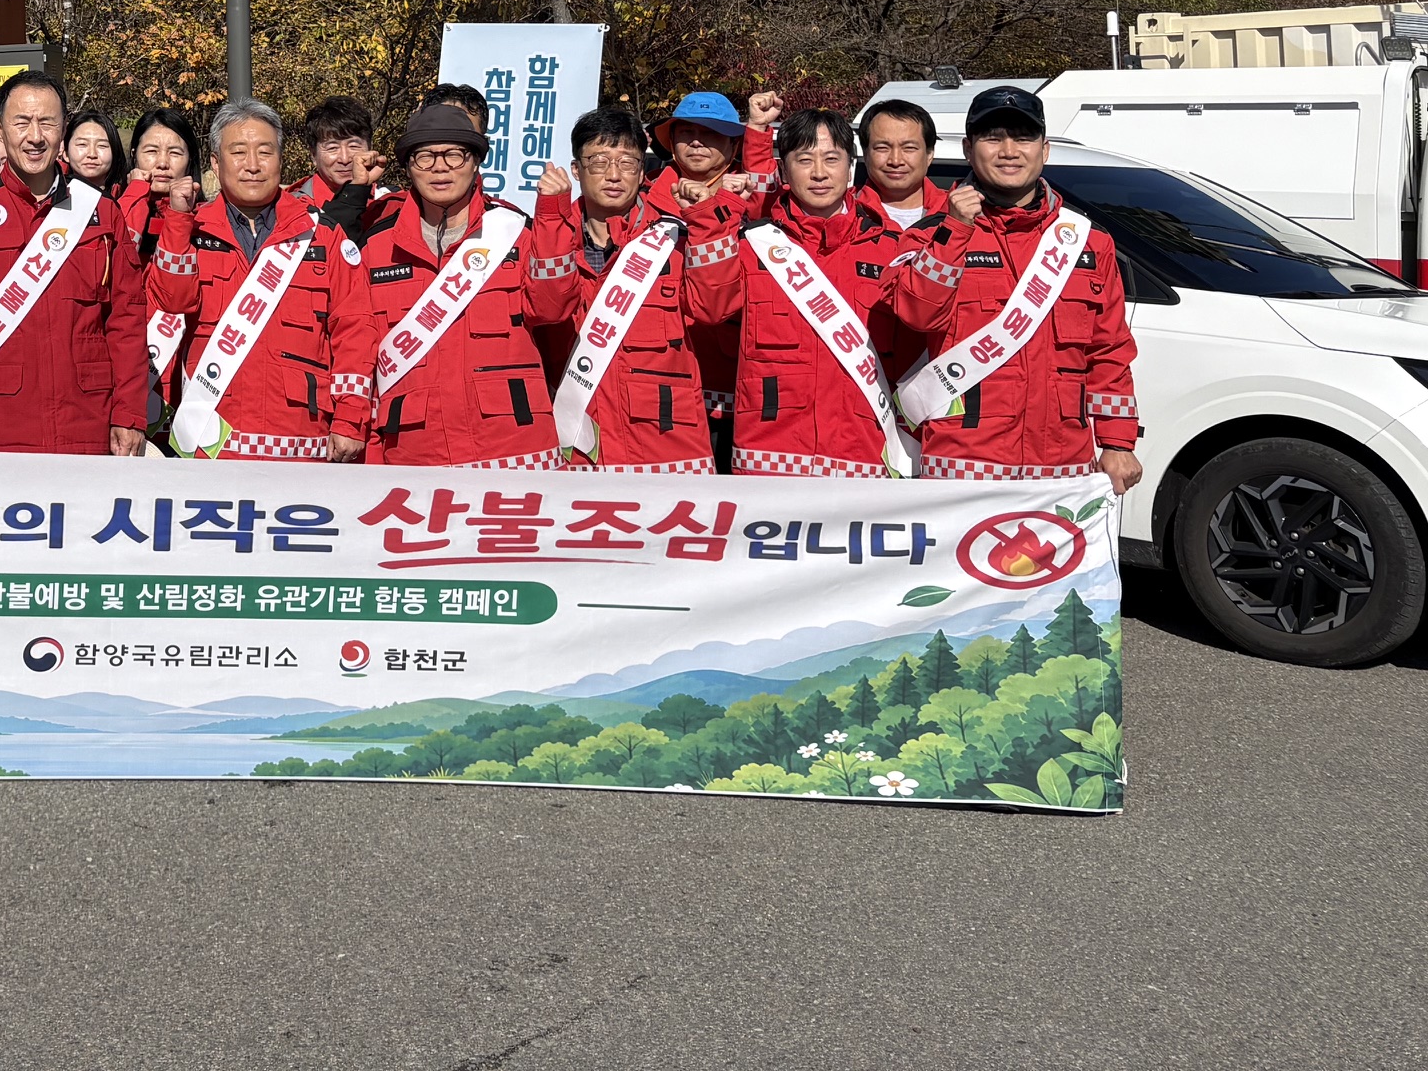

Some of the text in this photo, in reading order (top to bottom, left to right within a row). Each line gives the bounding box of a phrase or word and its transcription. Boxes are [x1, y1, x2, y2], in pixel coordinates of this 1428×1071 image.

[518, 54, 560, 192] 함께해요
[587, 228, 671, 349] 산불예방
[969, 245, 1069, 365] 산불예방
[377, 272, 472, 378] 산불예방
[785, 259, 880, 386] 산불예방
[196, 373, 221, 397] 서부지방산림청
[933, 364, 958, 395] 서부지방산림청
[91, 497, 339, 554] 시작은
[100, 582, 125, 610] 및
[135, 582, 245, 613] 산림정화
[254, 583, 365, 614] 유관기관
[374, 585, 428, 616] 합동
[438, 586, 519, 618] 캠페인
[73, 641, 300, 670] 함양국유림관리소
[383, 647, 468, 672] 합천군
